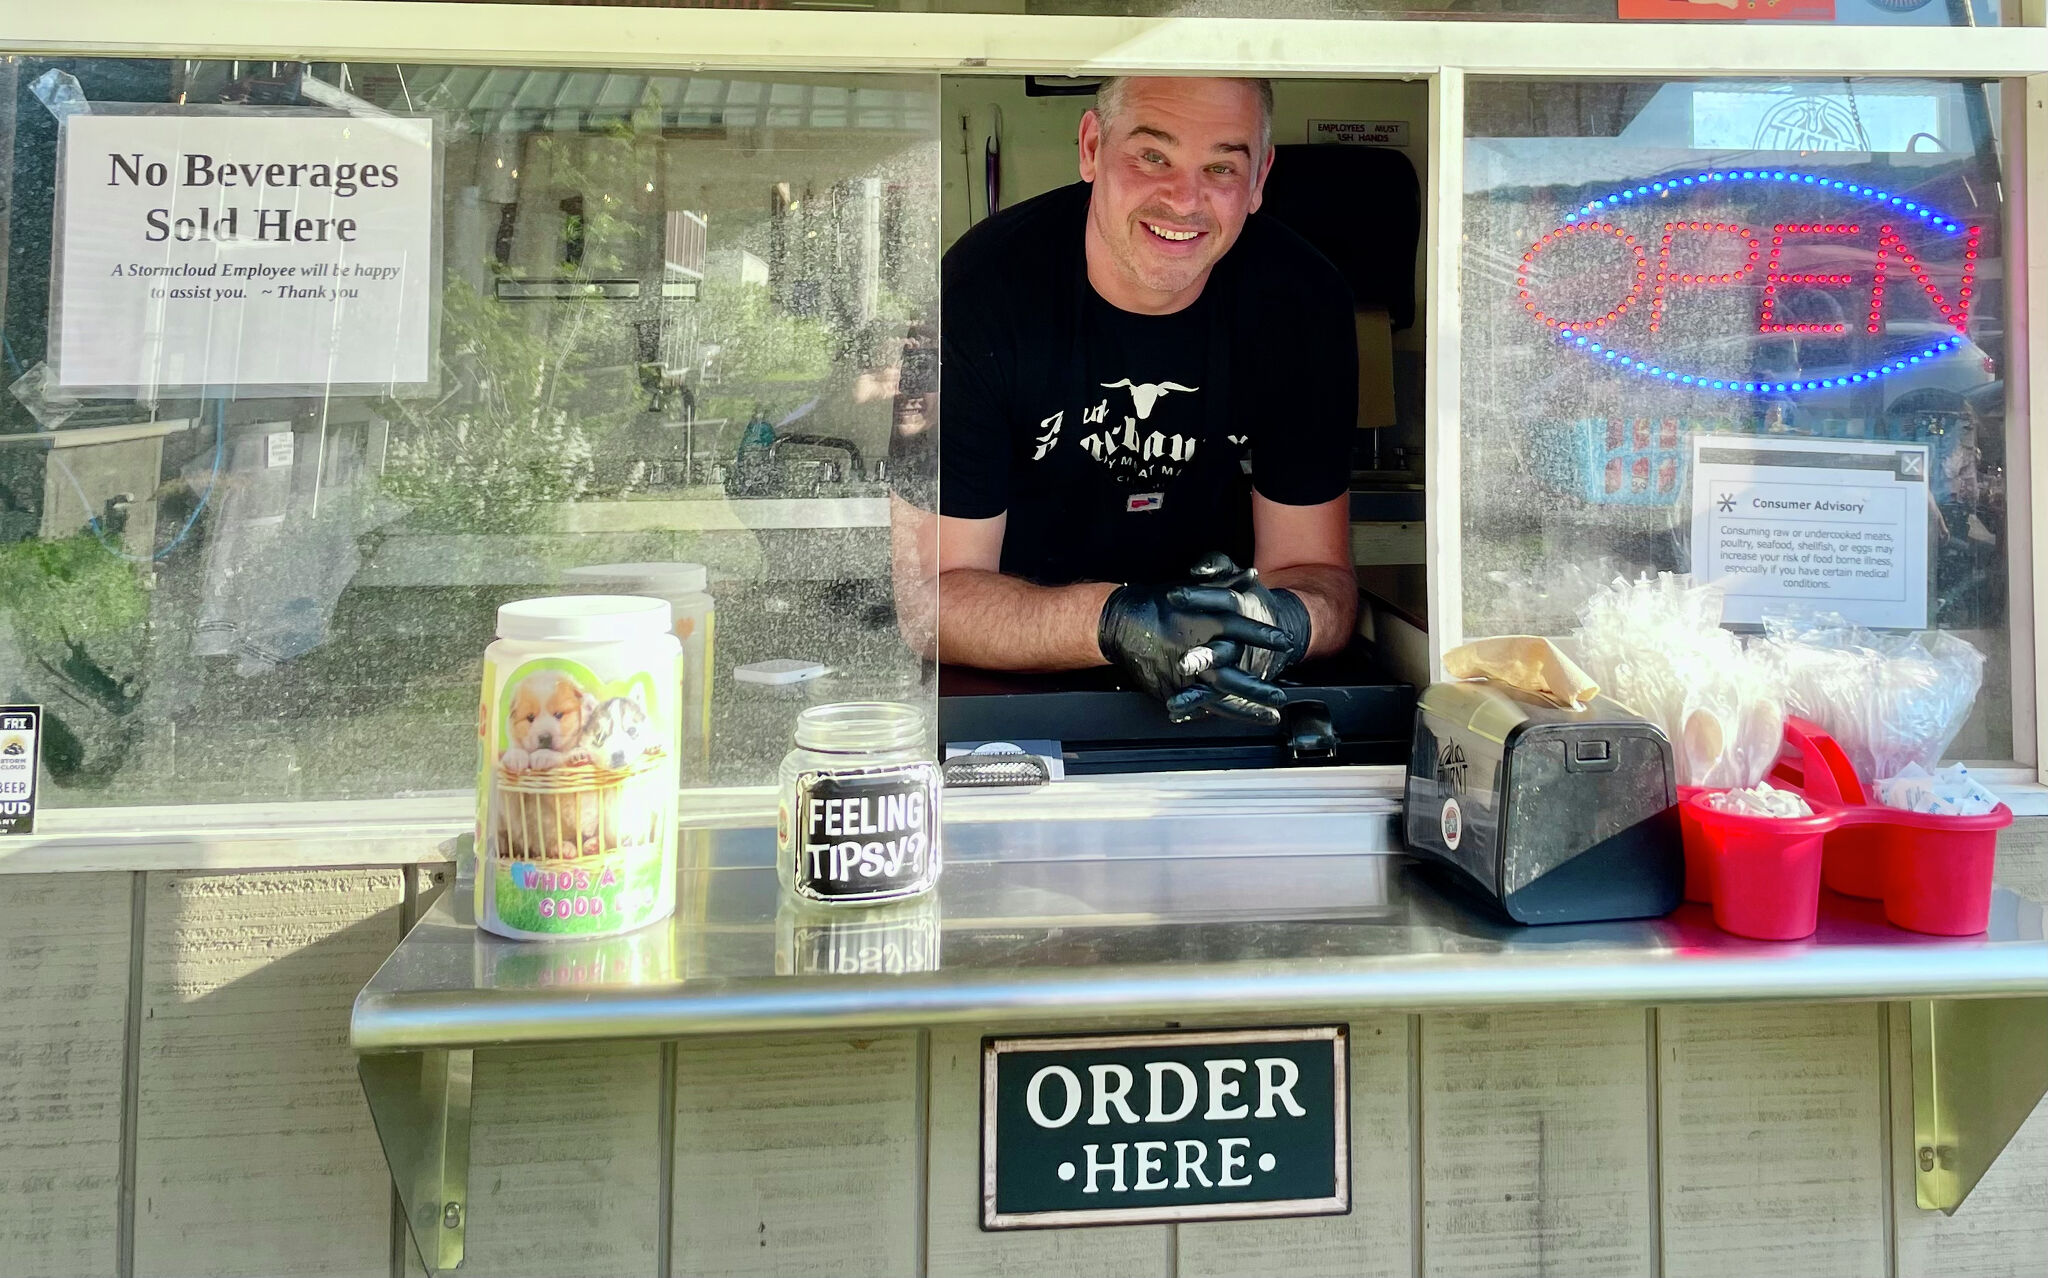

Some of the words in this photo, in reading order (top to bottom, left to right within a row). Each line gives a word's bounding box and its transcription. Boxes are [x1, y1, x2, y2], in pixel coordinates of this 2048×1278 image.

[1317, 123, 1365, 133] EMPLOYEES
[1375, 124, 1399, 133] MUST
[1358, 133, 1389, 142] HANDS
[107, 153, 168, 187] No
[183, 152, 399, 197] Beverages
[145, 207, 237, 243] Sold
[254, 208, 358, 243] Here
[111, 264, 123, 277] A
[127, 263, 217, 277] Stormcloud
[221, 263, 296, 280] Employee
[300, 263, 328, 277] will
[332, 263, 350, 277] be
[354, 263, 400, 280] happy
[1518, 222, 1981, 334] OPEN
[151, 286, 165, 299] to
[170, 285, 211, 299] assist
[215, 288, 247, 302] you.
[278, 285, 326, 299] Thank
[331, 288, 358, 302] you
[1752, 498, 1811, 510] Consumer
[1814, 501, 1865, 514] Advisory
[1720, 525, 1770, 538] Consuming
[1773, 529, 1789, 537] raw
[1792, 530, 1802, 538] or
[1804, 528, 1861, 540] undercooked
[1864, 532, 1894, 542] meats,
[1720, 539, 1753, 550] poultry,
[1757, 541, 1795, 551] seafood,
[1798, 541, 1836, 553] shellfish,
[1839, 544, 1849, 552] or
[1851, 544, 1872, 554] eggs
[1875, 546, 1893, 555] may
[1720, 551, 1757, 561] increase
[1759, 554, 1780, 563] your
[1783, 552, 1798, 562] risk
[1801, 553, 1811, 563] of
[1813, 554, 1832, 564] food
[1836, 555, 1861, 565] borne
[1724, 564, 1767, 575] especially
[1770, 564, 1776, 574] if
[1779, 567, 1797, 577] you
[1800, 566, 1820, 576] have
[1823, 567, 1852, 577] certain
[1855, 568, 1889, 578] medical
[1783, 578, 1831, 589] conditions.
[4, 718, 27, 729] FRI
[809, 791, 924, 836] FEELING
[805, 832, 927, 881] TIPSY?
[523, 868, 589, 893] WHO'S
[602, 867, 616, 886] A
[539, 897, 604, 919] GOOD
[1026, 1057, 1306, 1128] ORDER
[1082, 1137, 1252, 1193] HERE
